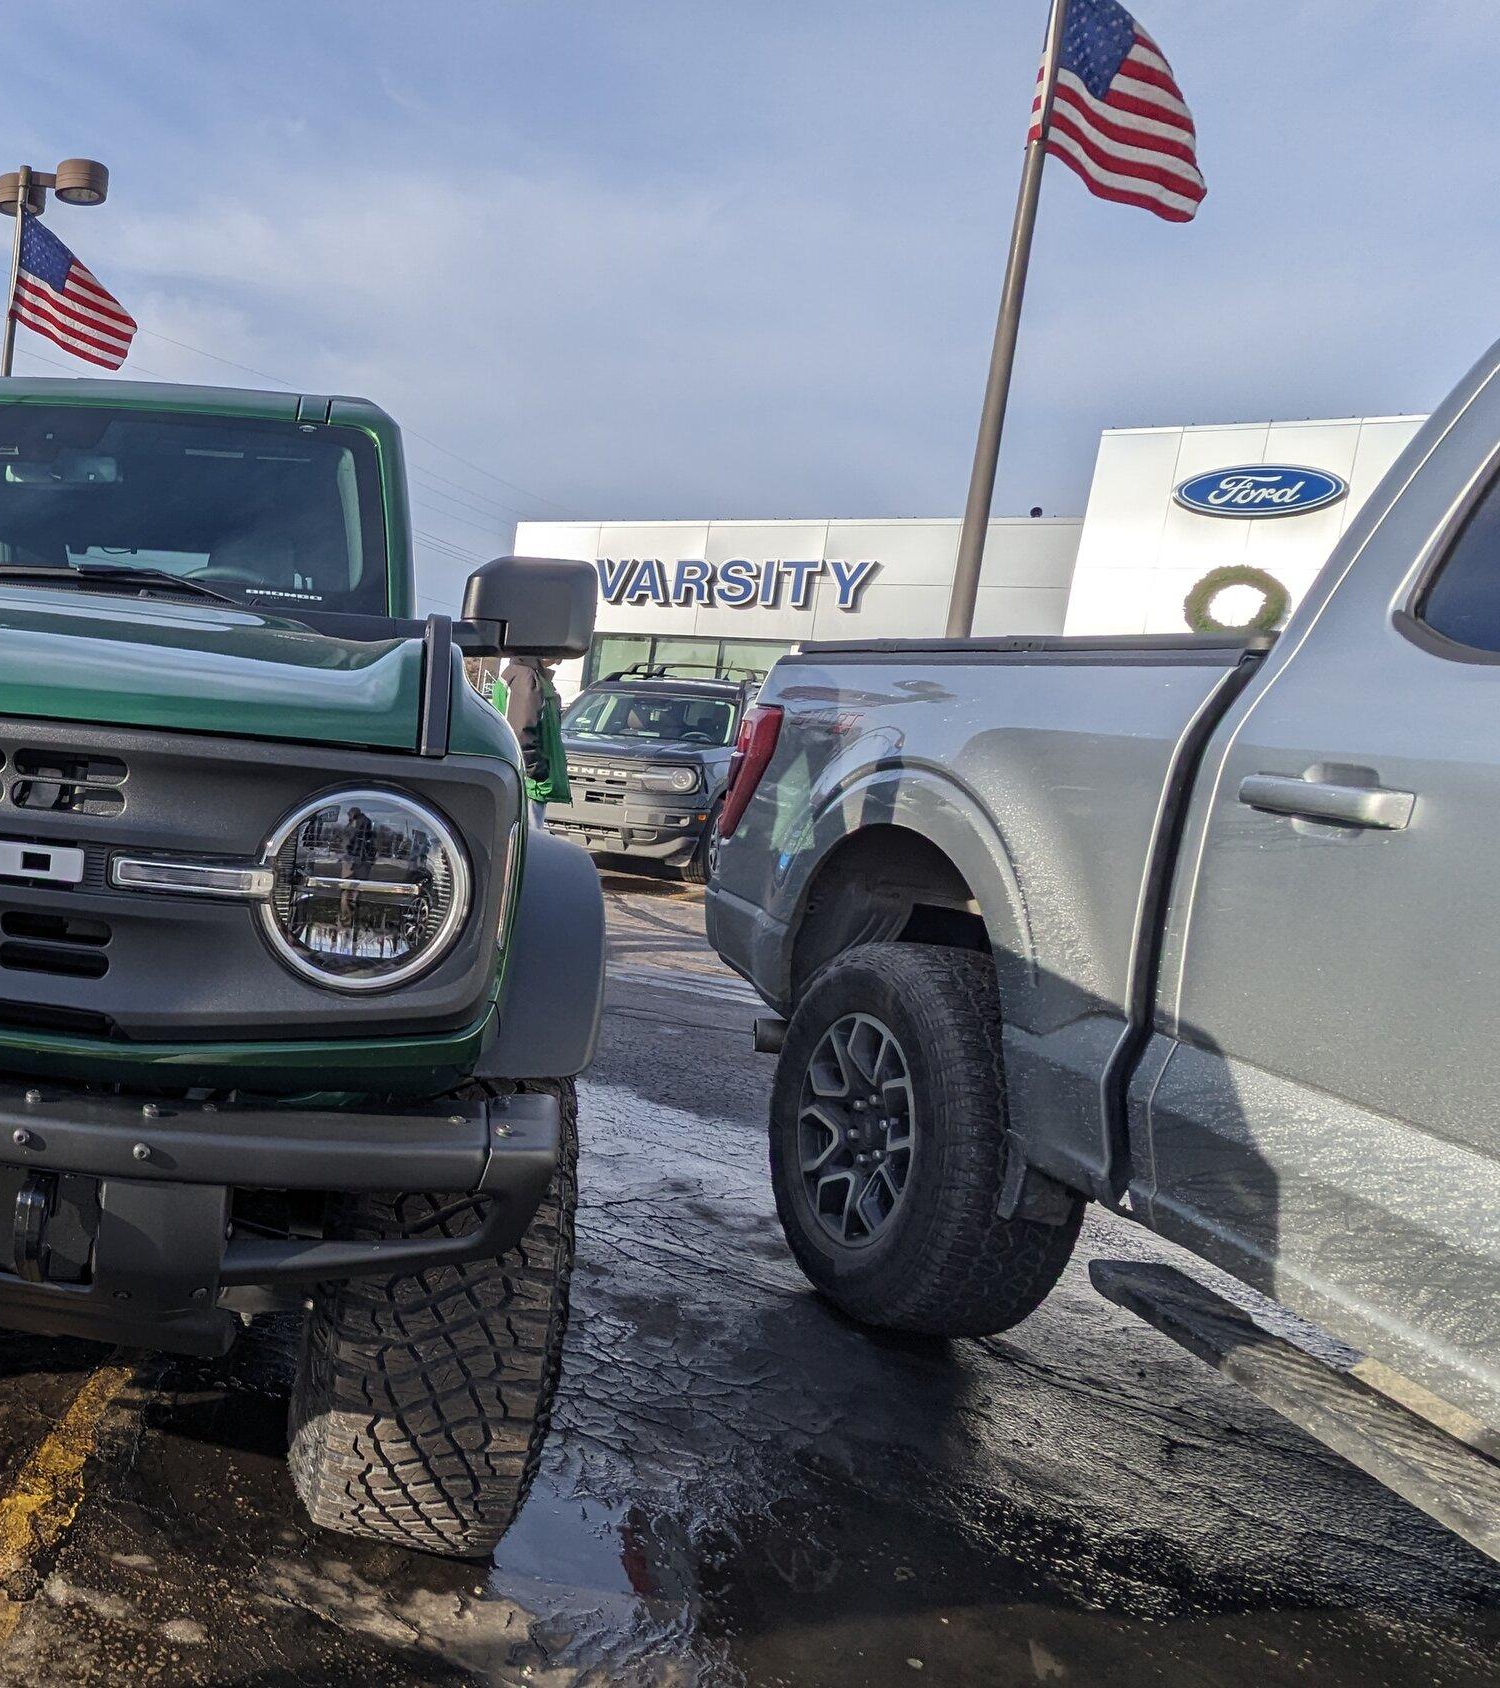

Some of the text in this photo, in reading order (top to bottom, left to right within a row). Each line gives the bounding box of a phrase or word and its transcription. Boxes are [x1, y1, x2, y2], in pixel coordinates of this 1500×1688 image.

[1207, 475, 1305, 504] Ford
[596, 556, 878, 609] VARSITY
[567, 766, 628, 779] ONCO
